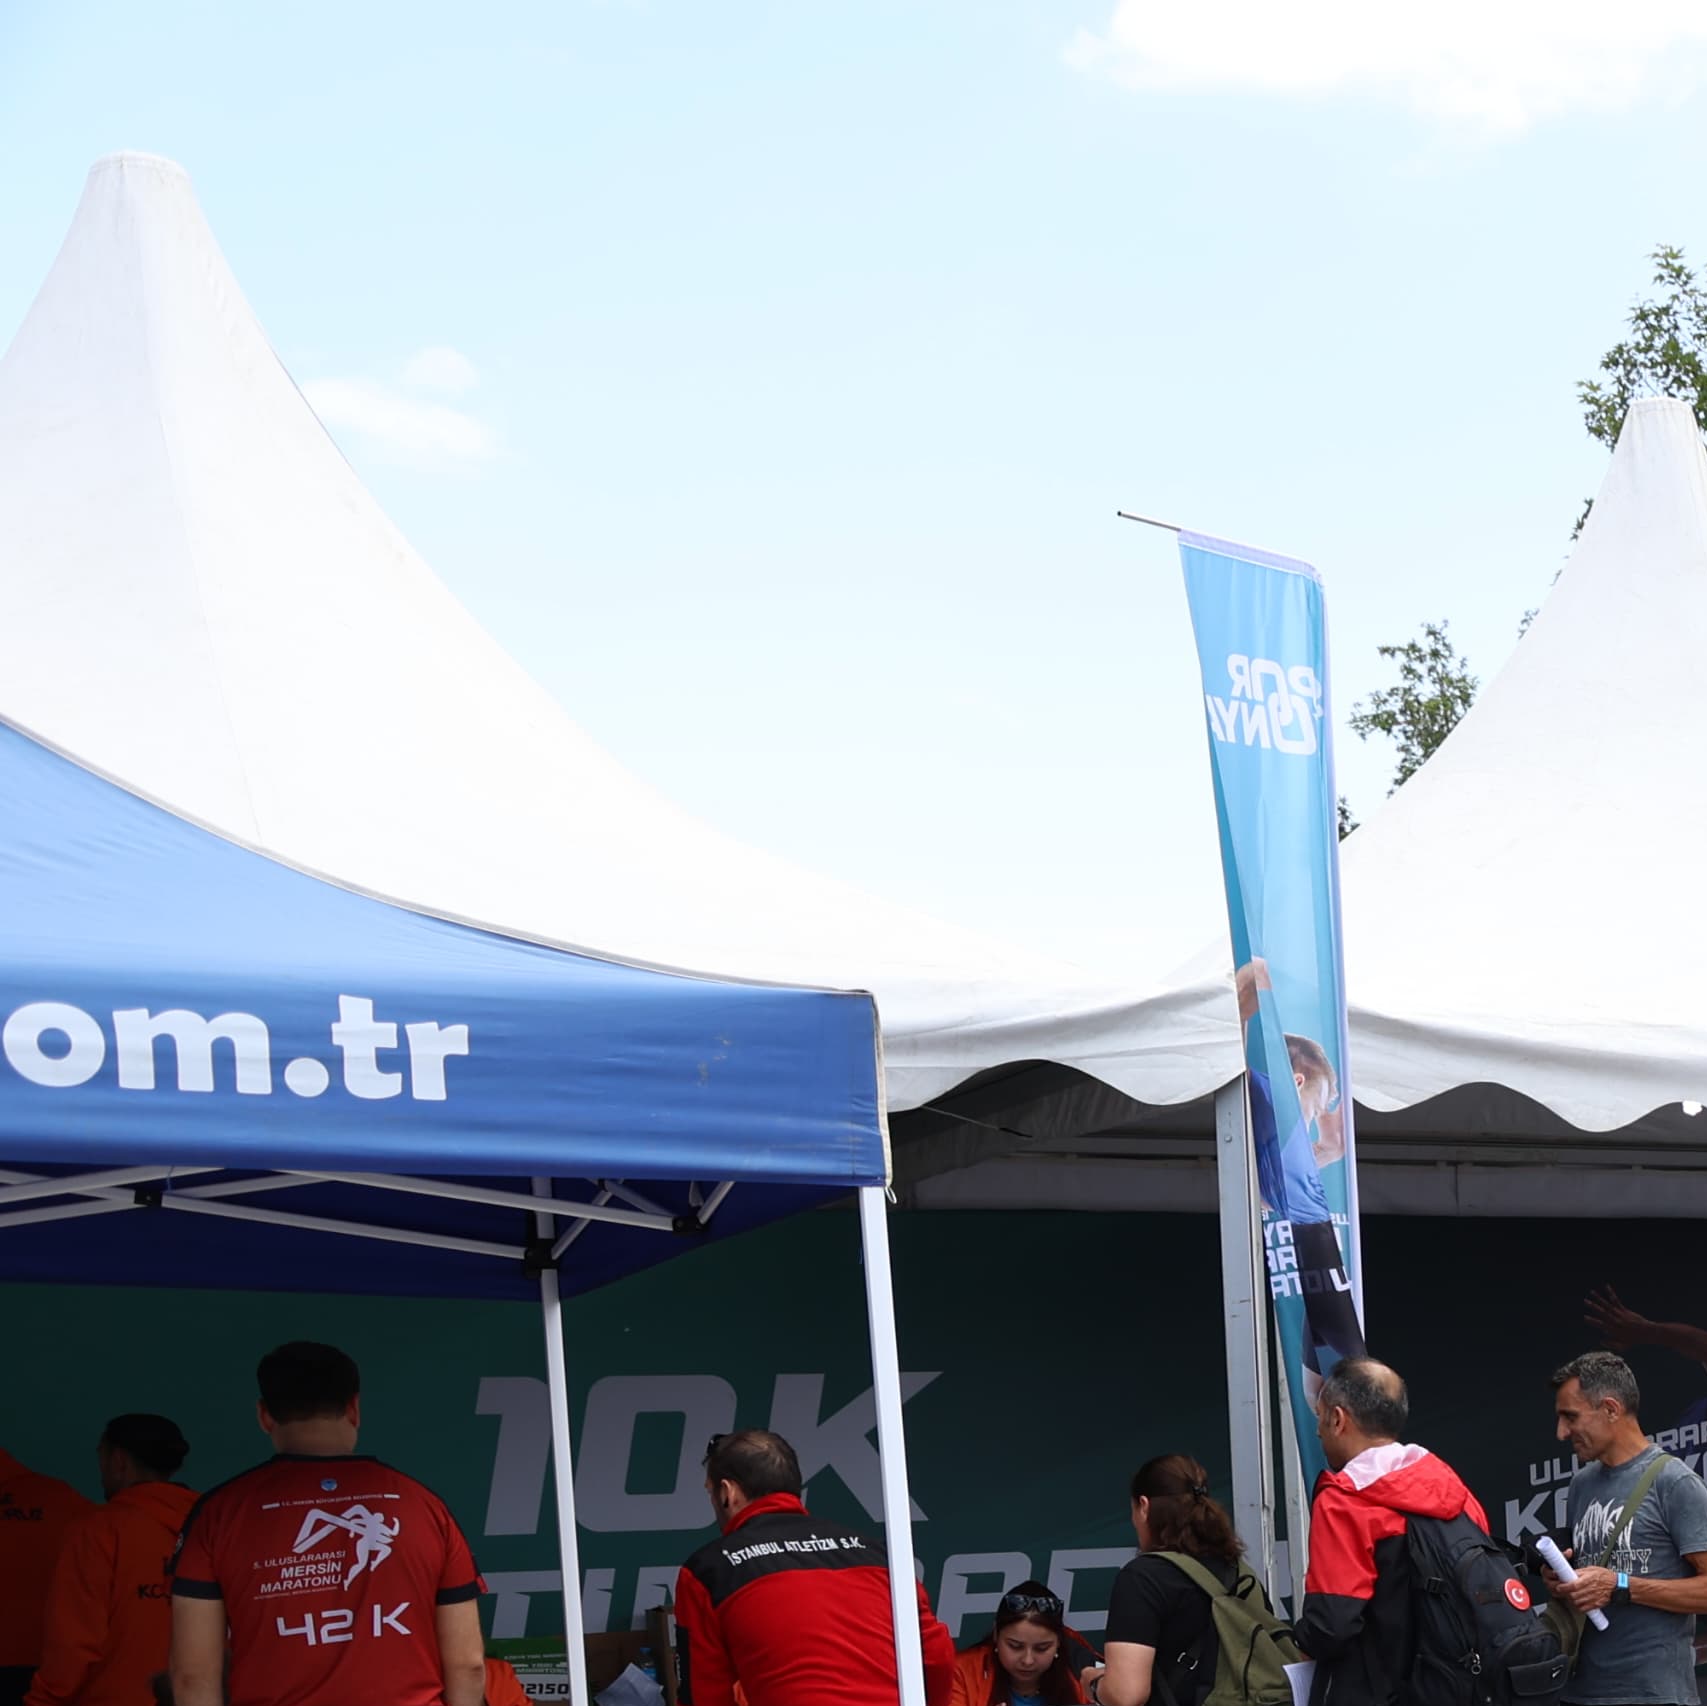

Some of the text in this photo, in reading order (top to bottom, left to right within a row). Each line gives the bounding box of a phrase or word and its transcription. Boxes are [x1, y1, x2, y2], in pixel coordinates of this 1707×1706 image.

[475, 1371, 943, 1536] 10K
[722, 1541, 785, 1567] İSTANBUL
[784, 1534, 839, 1552] ATLETİZM
[281, 1559, 342, 1579] MERSİN
[260, 1574, 342, 1594] MARATONU
[276, 1601, 412, 1646] 42 K
[521, 1683, 569, 1695] 2150
